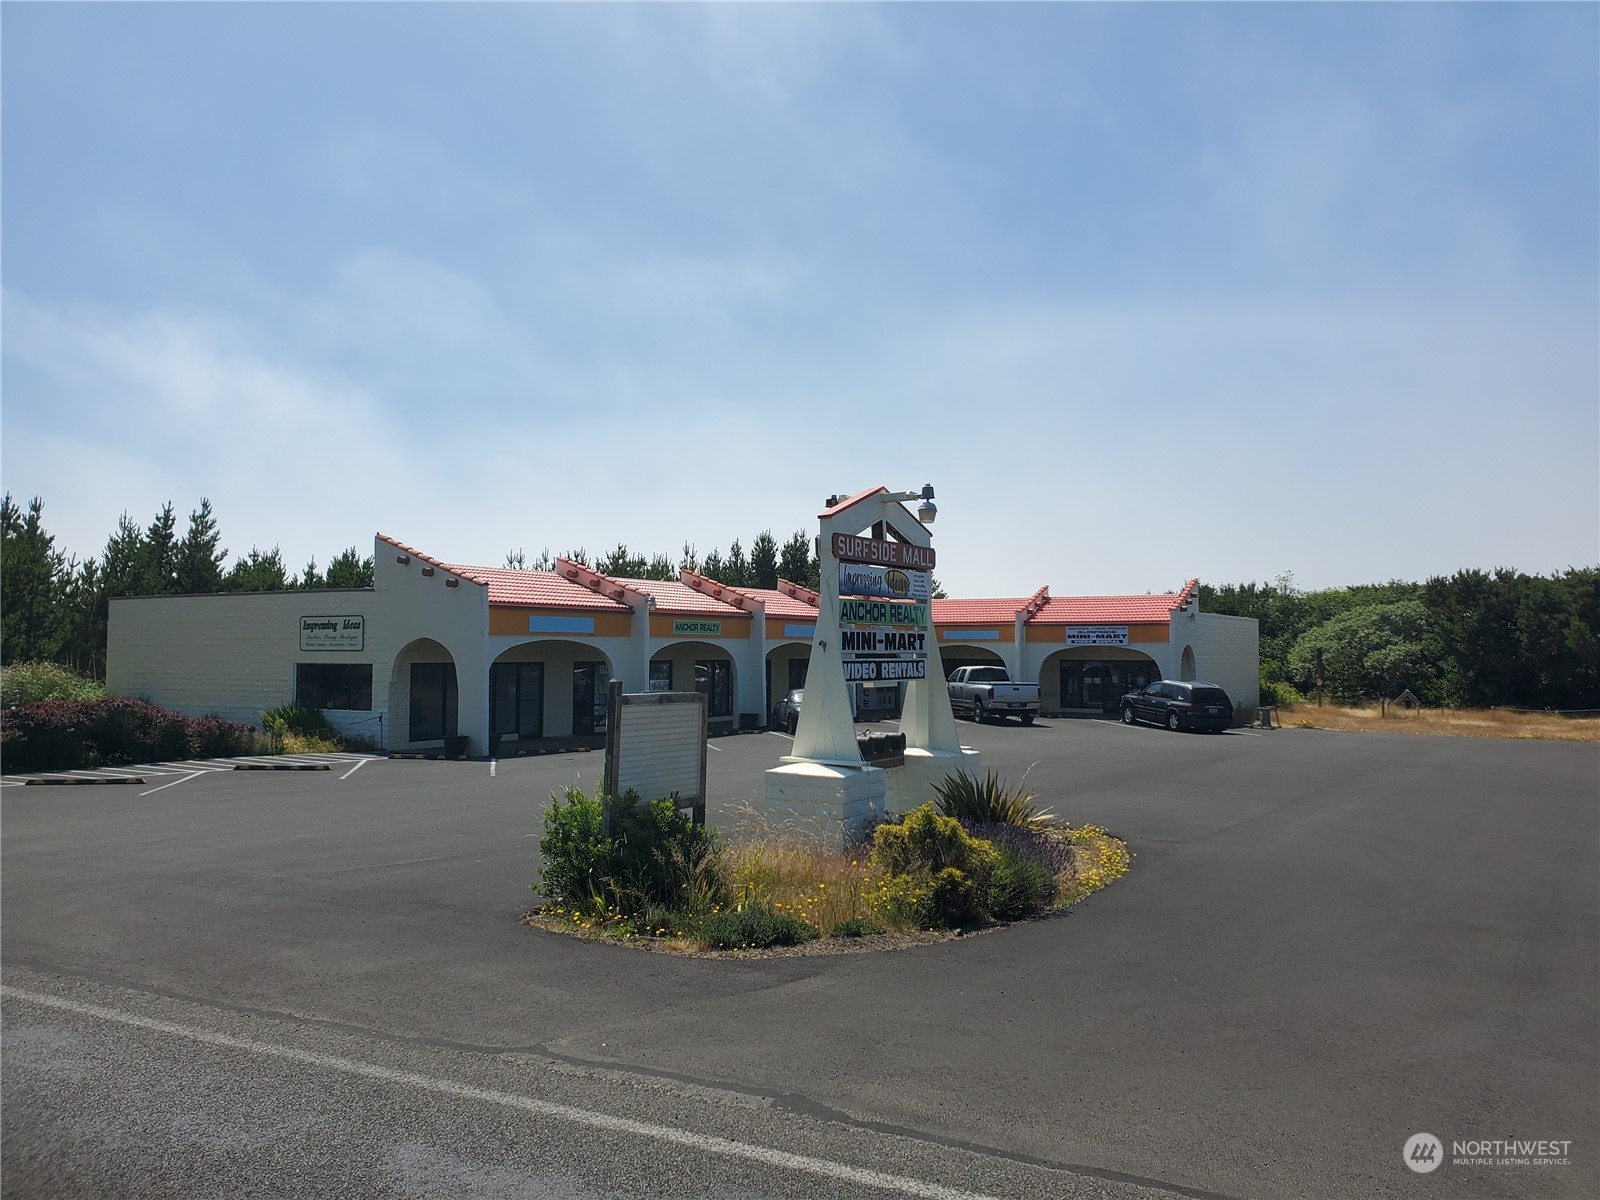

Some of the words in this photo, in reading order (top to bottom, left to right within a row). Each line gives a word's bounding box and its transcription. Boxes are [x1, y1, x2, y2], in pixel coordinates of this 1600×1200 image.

[838, 536, 897, 562] SURFSIDE
[903, 546, 933, 567] MALL
[843, 564, 882, 594] Impressing
[887, 570, 910, 597] Ideas
[841, 601, 887, 622] ANCHOR
[890, 604, 926, 624] REALTY
[302, 620, 338, 632] Impressing
[342, 619, 361, 630] Ideas
[675, 622, 699, 631] ANCHOR
[700, 623, 720, 632] REALTY
[842, 631, 925, 651] MINI-MART
[843, 662, 877, 679] VIDEO
[881, 661, 924, 678] RENTALS
